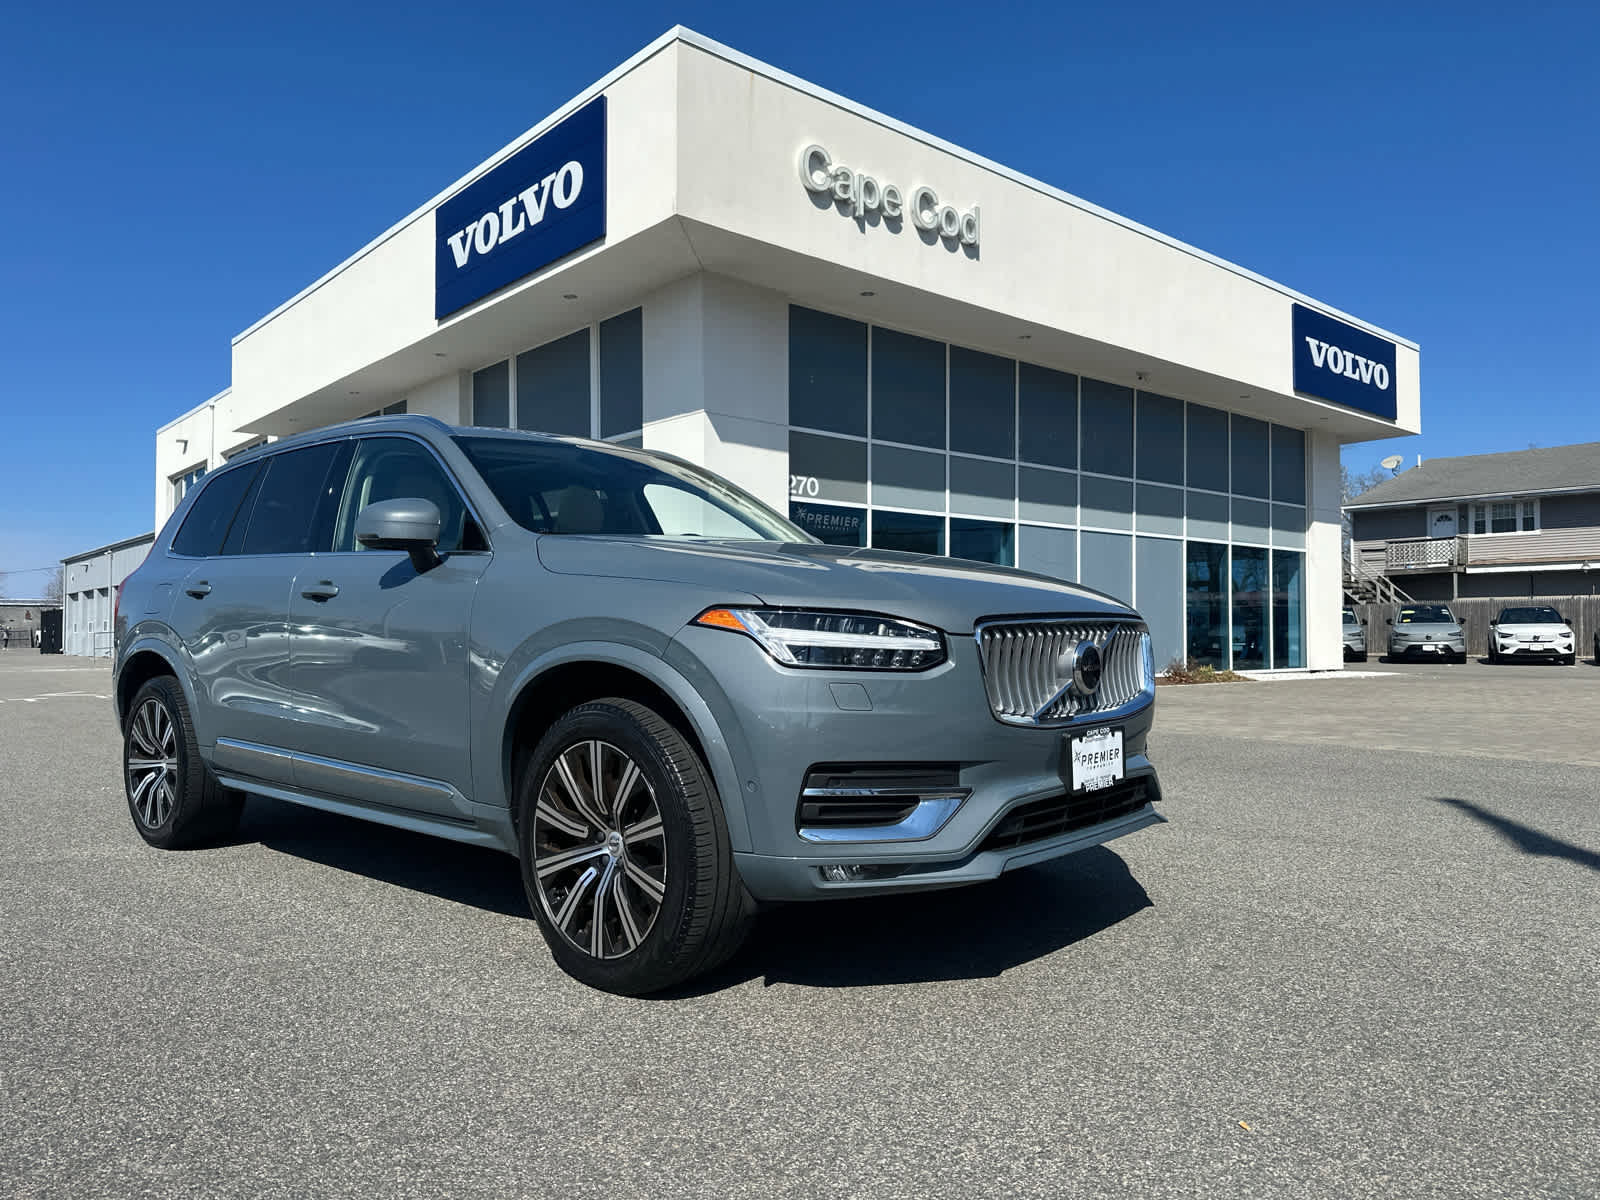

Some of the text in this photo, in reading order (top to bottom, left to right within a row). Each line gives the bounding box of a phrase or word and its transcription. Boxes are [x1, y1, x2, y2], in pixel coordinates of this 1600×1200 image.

[447, 160, 584, 269] VOLVO
[800, 144, 981, 246] Cape Cod
[1305, 336, 1390, 391] VOLVO
[806, 512, 860, 528] PREMIER
[1081, 747, 1120, 767] PREMIER
